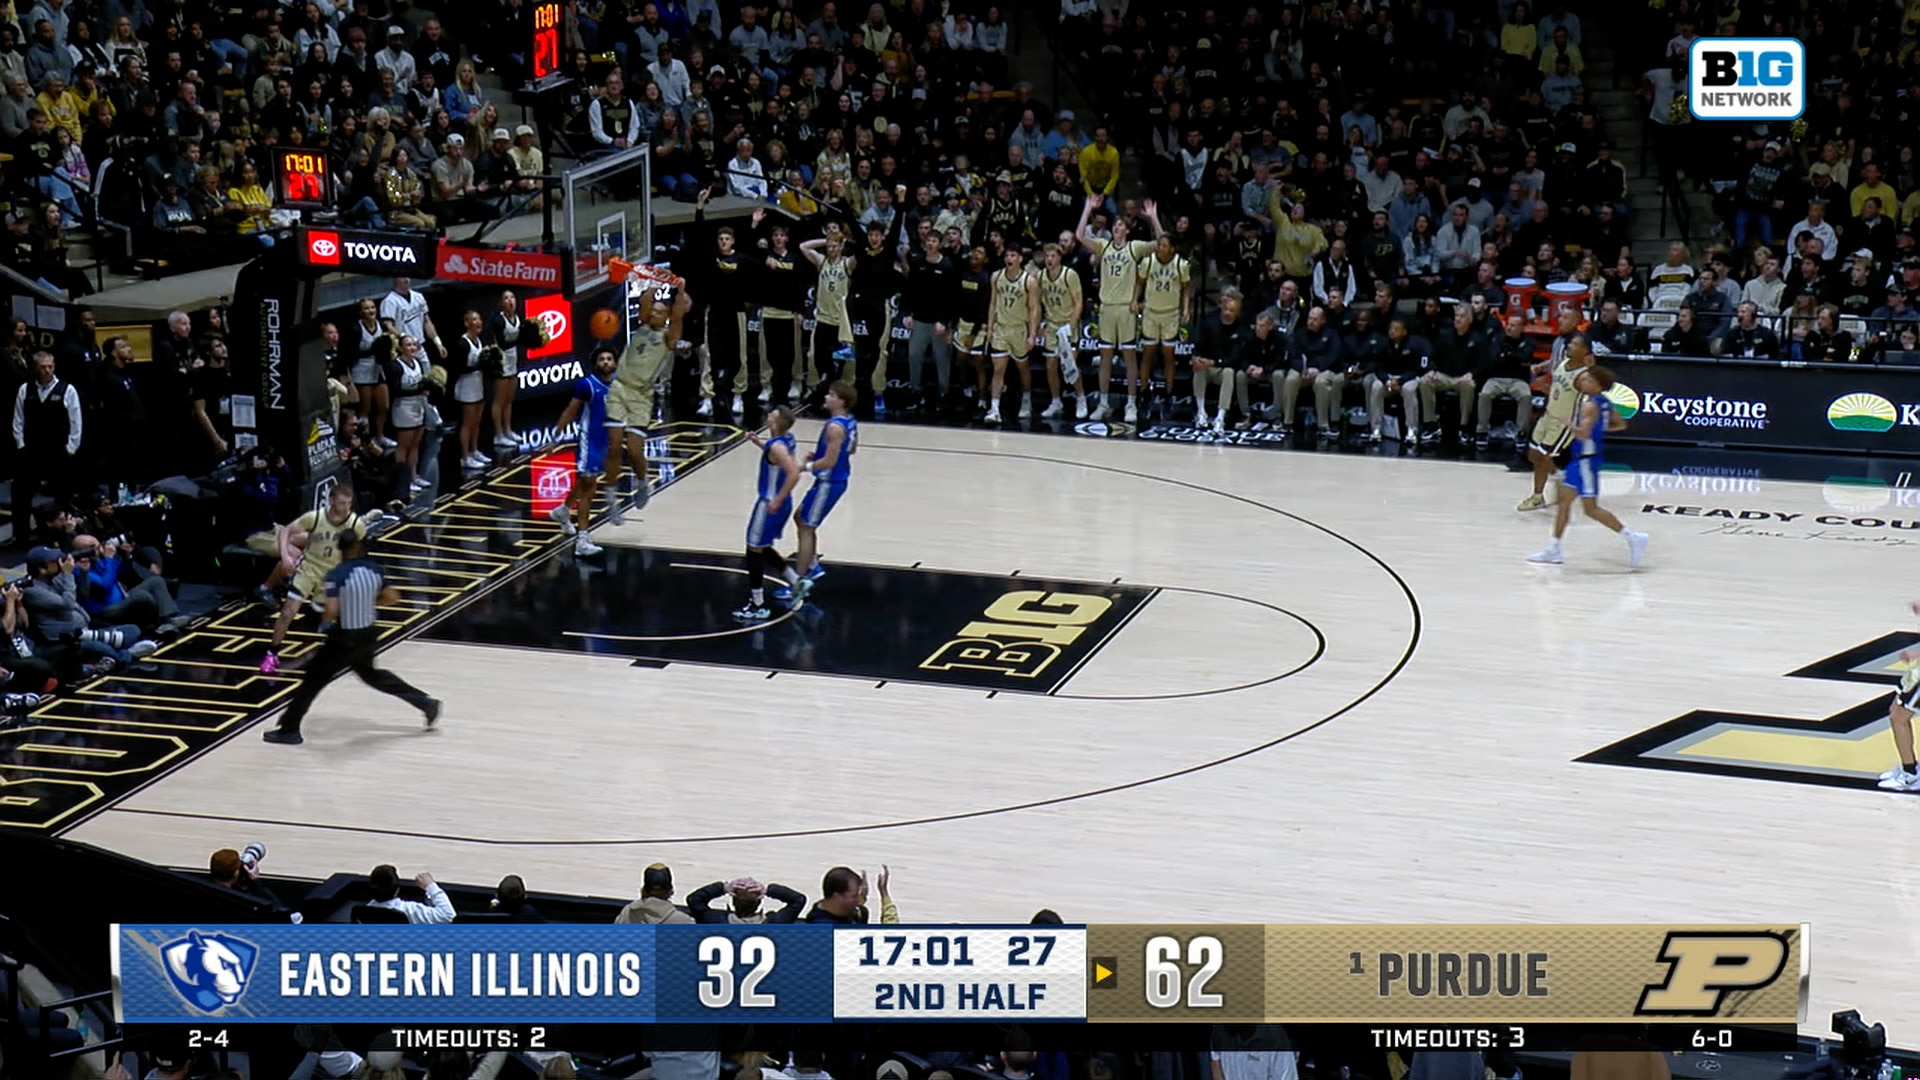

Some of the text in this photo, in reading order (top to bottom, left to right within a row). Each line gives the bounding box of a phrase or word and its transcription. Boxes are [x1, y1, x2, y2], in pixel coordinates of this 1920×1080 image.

[535, 29, 558, 77] 27
[286, 154, 323, 174] 17:01
[290, 173, 319, 199] 27
[344, 242, 416, 263] TOYOTA
[1110, 265, 1122, 276] 12
[1156, 280, 1170, 292] 24
[1004, 297, 1016, 309] 17
[264, 298, 286, 409] ROHRMAN
[517, 361, 584, 389] TOYOTA
[1641, 391, 1767, 421] Keystone
[1684, 415, 1766, 430] COOPERATIVE
[1642, 503, 1803, 522] KEADY
